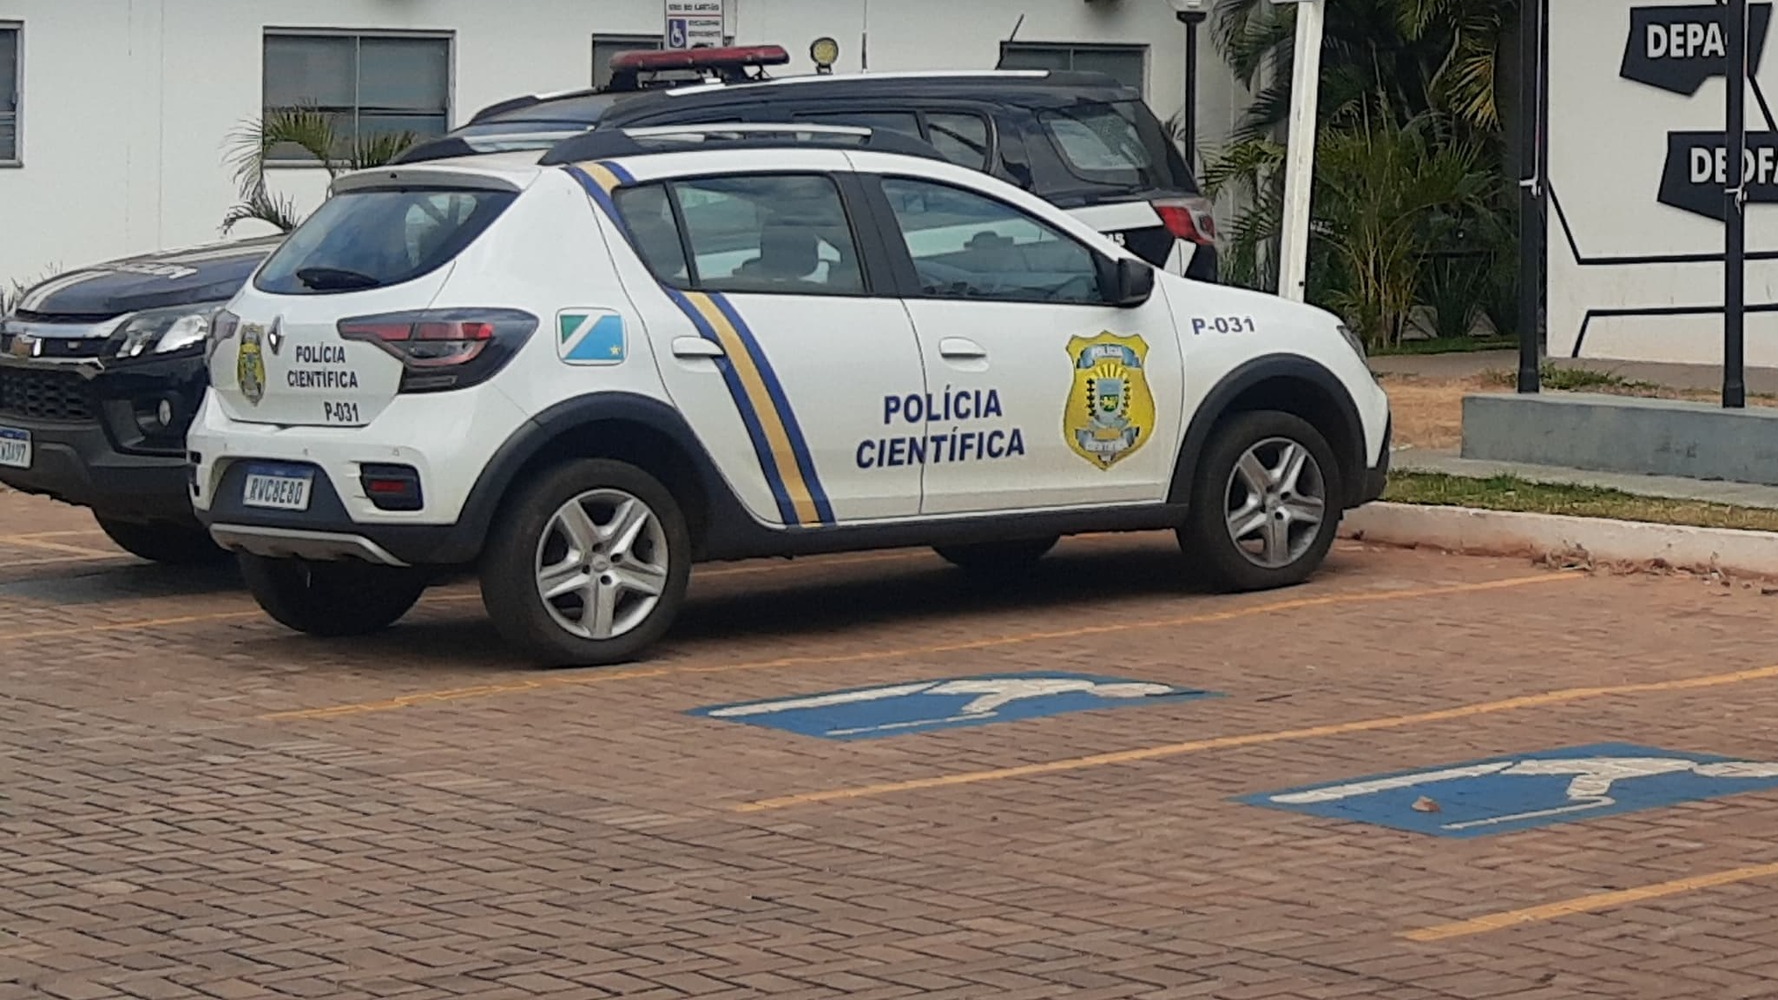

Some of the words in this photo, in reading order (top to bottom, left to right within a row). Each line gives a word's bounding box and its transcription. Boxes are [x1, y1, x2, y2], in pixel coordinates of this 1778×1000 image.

[1647, 22, 1728, 59] DEPA
[1191, 316, 1255, 335] P-031
[295, 341, 347, 363] POLÍCIA
[287, 364, 359, 388] CIENTÍFICA
[323, 401, 360, 422] P-031
[884, 384, 1003, 425] POLÍCIA
[856, 426, 1025, 469] CIENTÍFICA
